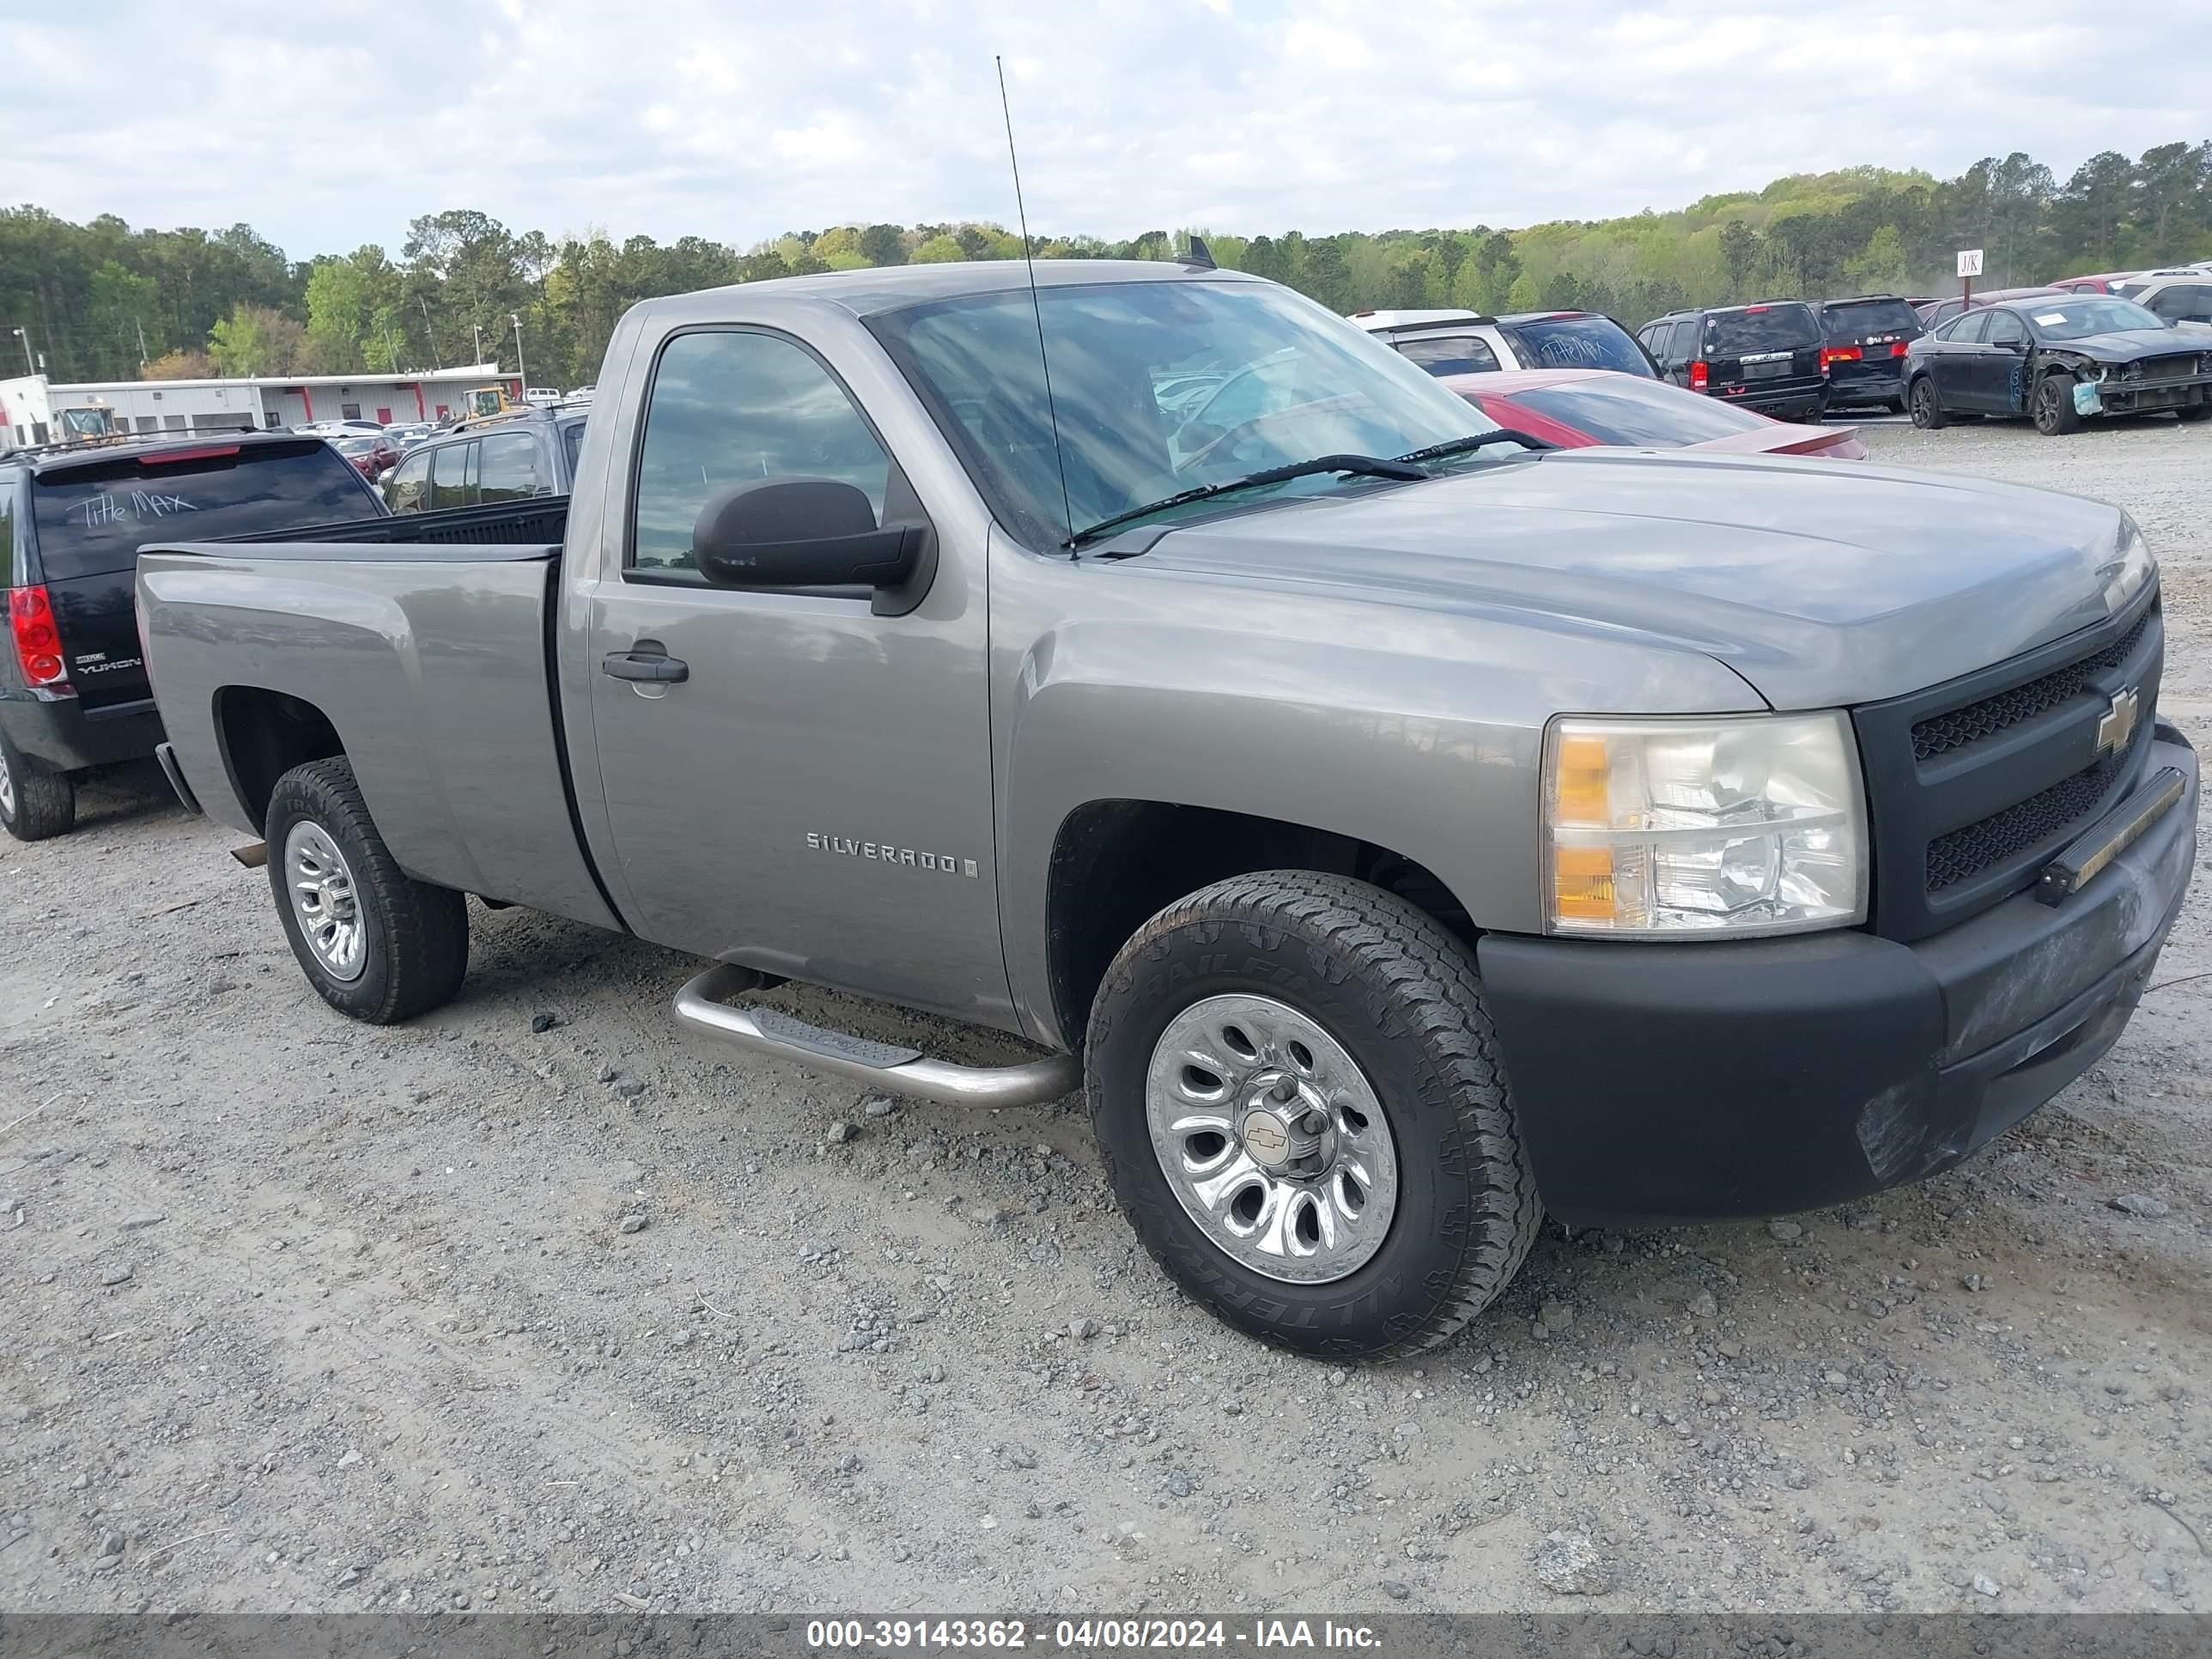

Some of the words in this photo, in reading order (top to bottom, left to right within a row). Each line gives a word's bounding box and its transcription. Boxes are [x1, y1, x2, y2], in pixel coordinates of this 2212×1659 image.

[1961, 253, 1978, 272] J/K
[65, 493, 127, 529] Title
[76, 658, 142, 675] YUKON
[805, 832, 957, 873] SILVERADO
